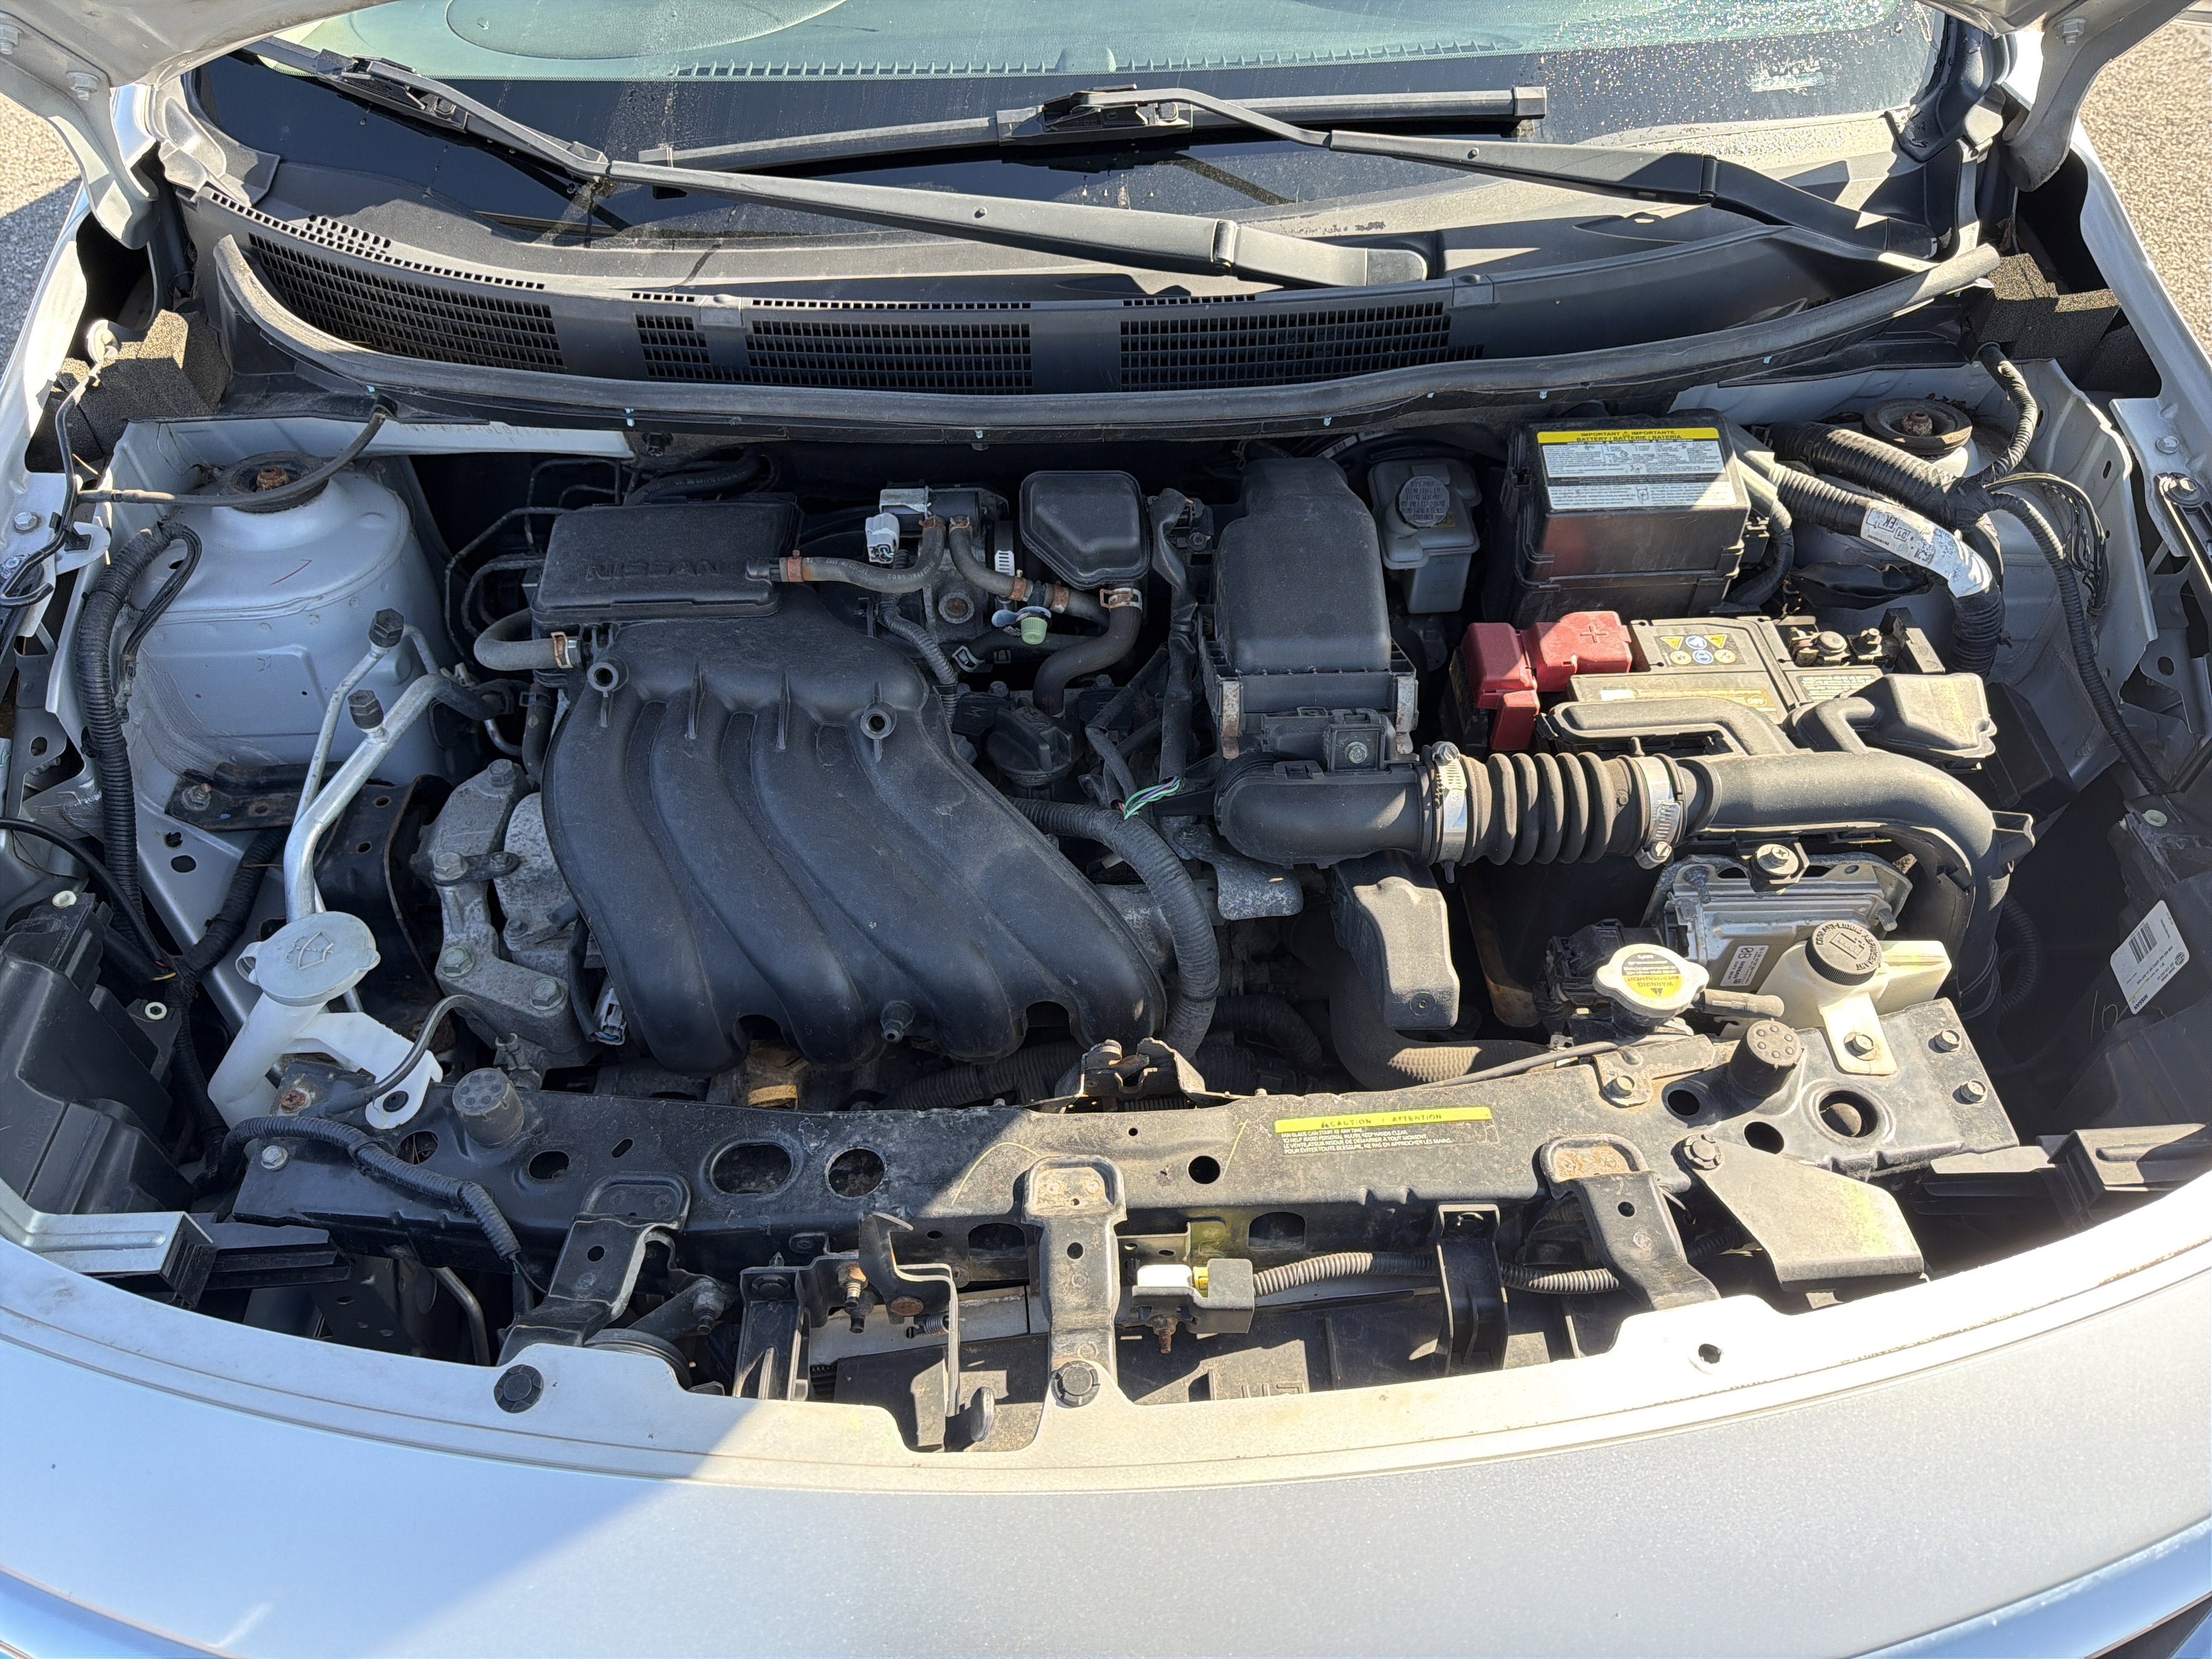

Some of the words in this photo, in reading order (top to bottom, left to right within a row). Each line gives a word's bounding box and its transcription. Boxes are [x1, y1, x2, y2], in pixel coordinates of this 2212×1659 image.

[586, 561, 721, 580] NISSAN
[1733, 961, 1746, 979] NISSAN
[2134, 994, 2148, 1010] NISSAN
[1330, 1119, 1371, 1127] CAUTION
[1392, 1114, 1442, 1122] ATTENTION
